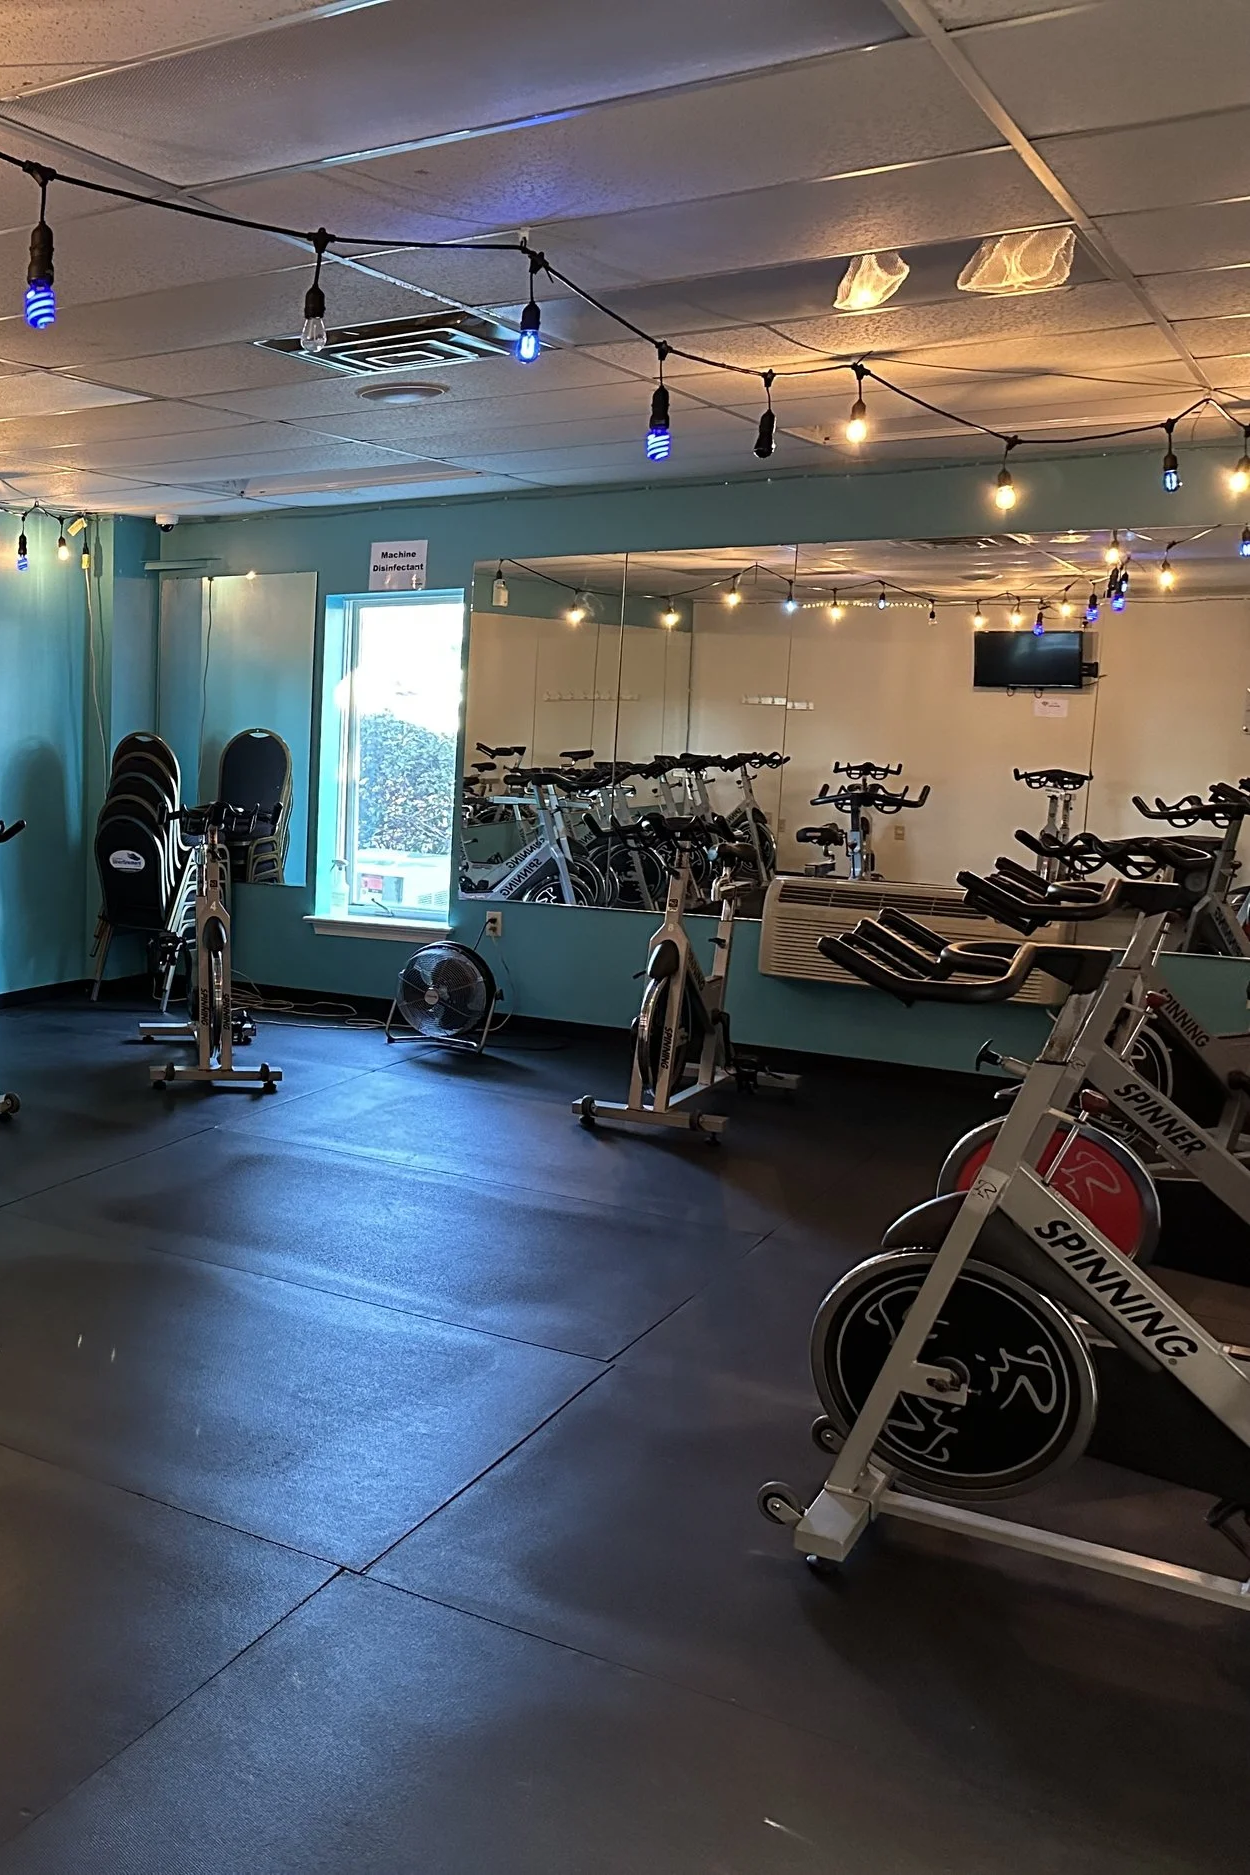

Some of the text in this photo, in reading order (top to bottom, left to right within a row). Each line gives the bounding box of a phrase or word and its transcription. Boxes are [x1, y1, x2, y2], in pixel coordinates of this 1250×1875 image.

[373, 563, 424, 572] Disinfectant
[381, 551, 417, 559] Machine
[210, 901, 217, 911] 4
[661, 1027, 673, 1069] SPINNING
[1113, 1084, 1206, 1156] SPINNER
[1034, 1220, 1198, 1358] SPINNING
